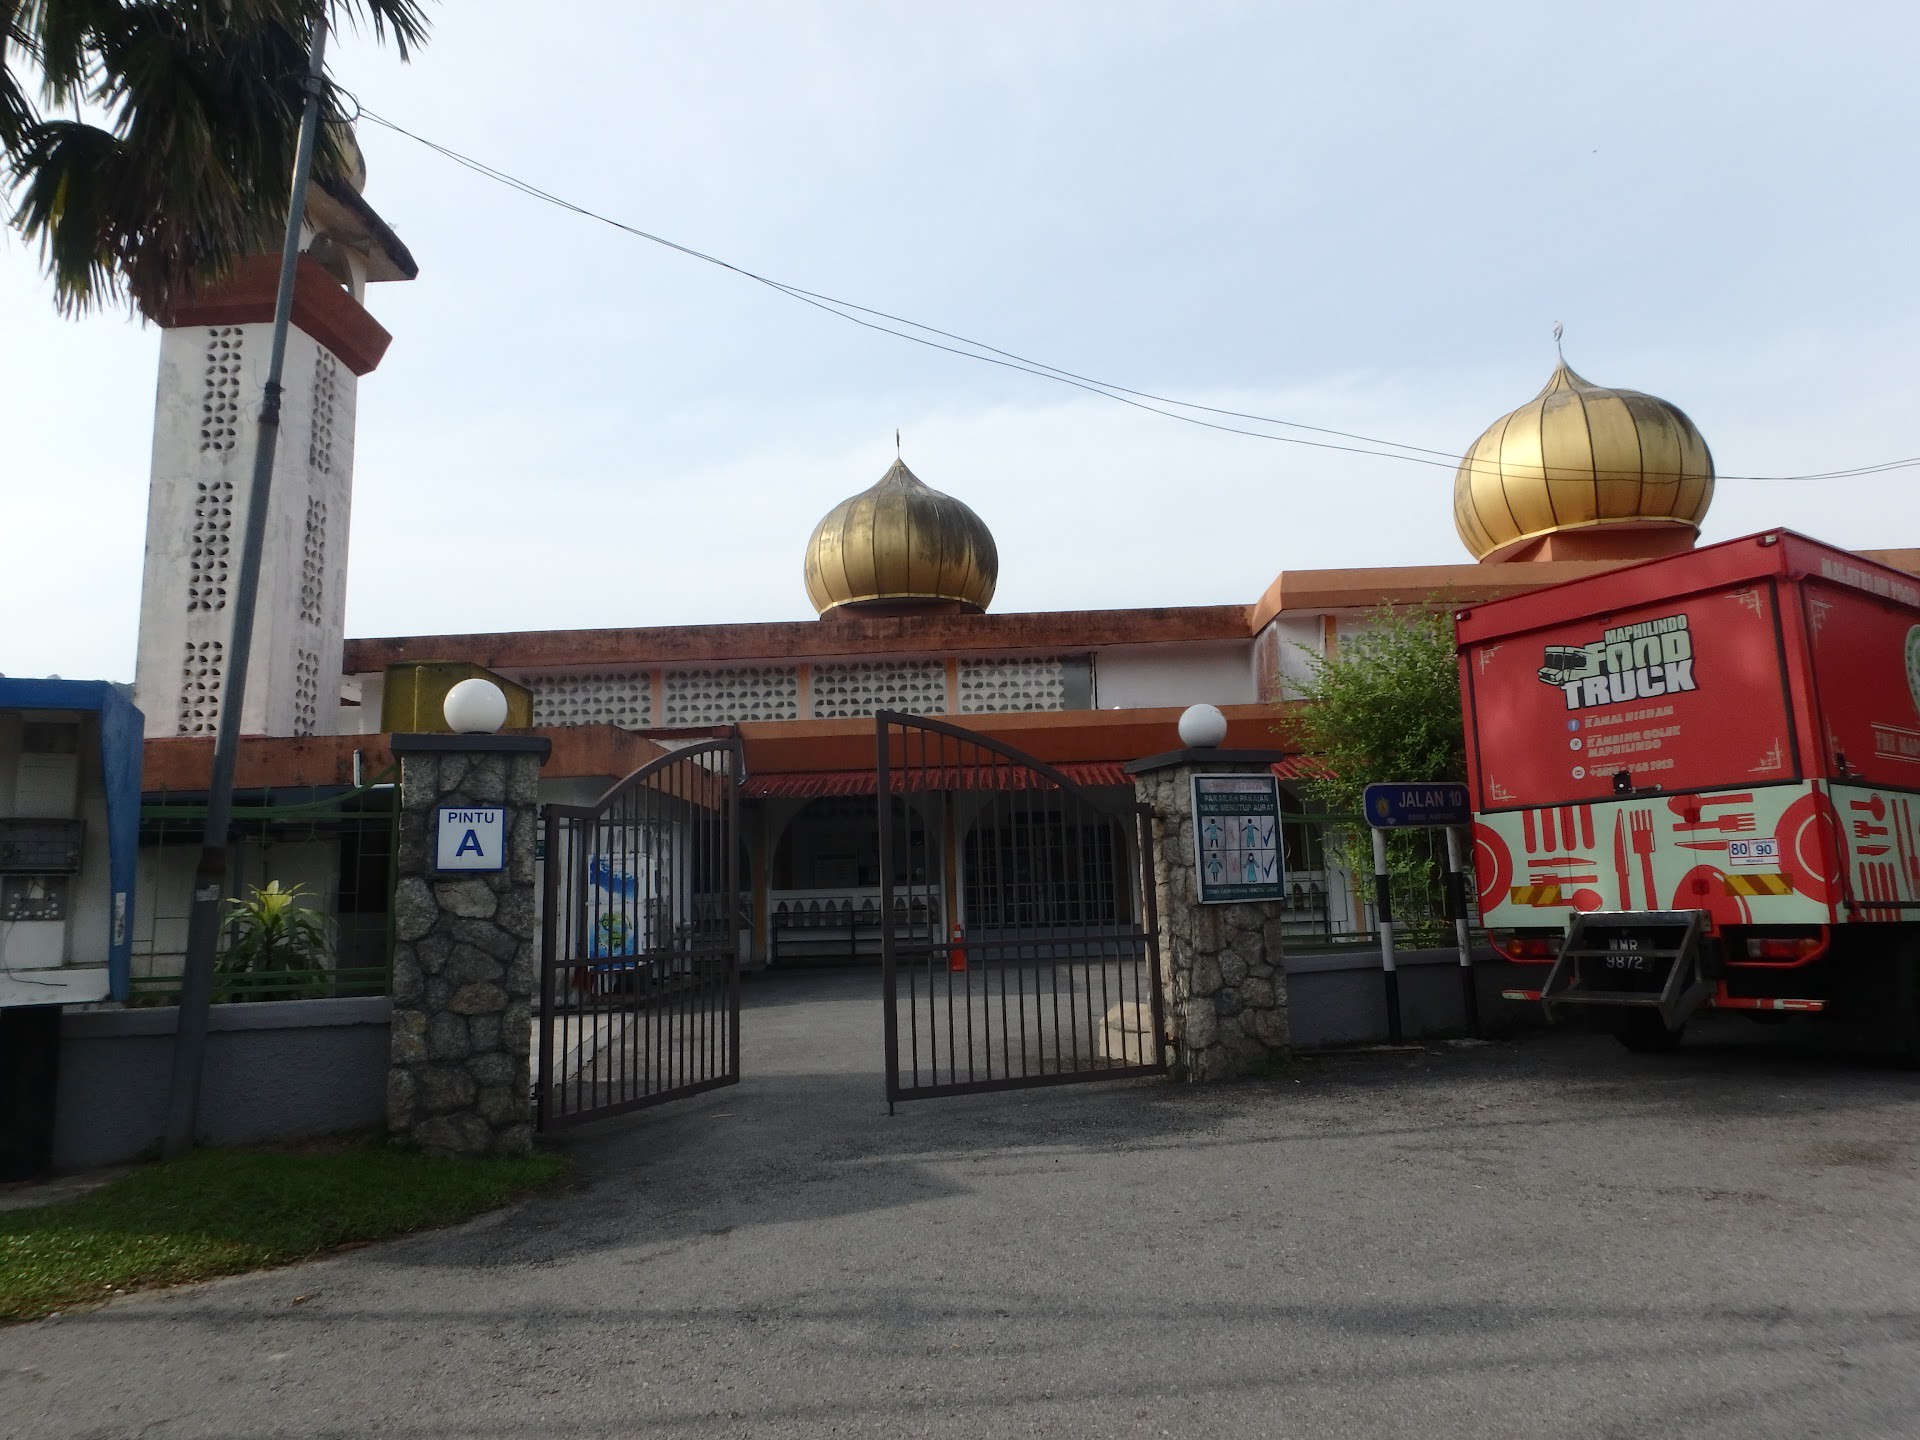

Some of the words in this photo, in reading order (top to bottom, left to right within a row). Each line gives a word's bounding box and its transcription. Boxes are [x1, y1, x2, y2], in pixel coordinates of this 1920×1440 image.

[1604, 614, 1687, 644] MAPHILINDO
[1583, 631, 1691, 676] FOOD
[1561, 660, 1696, 709] TRUCK
[1399, 791, 1444, 808] JALAN
[1448, 790, 1462, 807] 10
[448, 812, 494, 823] PINTU
[455, 829, 484, 857] A
[1731, 843, 1748, 855] 80
[1756, 844, 1772, 855] 90
[1608, 938, 1638, 950] WMR
[1606, 956, 1643, 969] 9872
